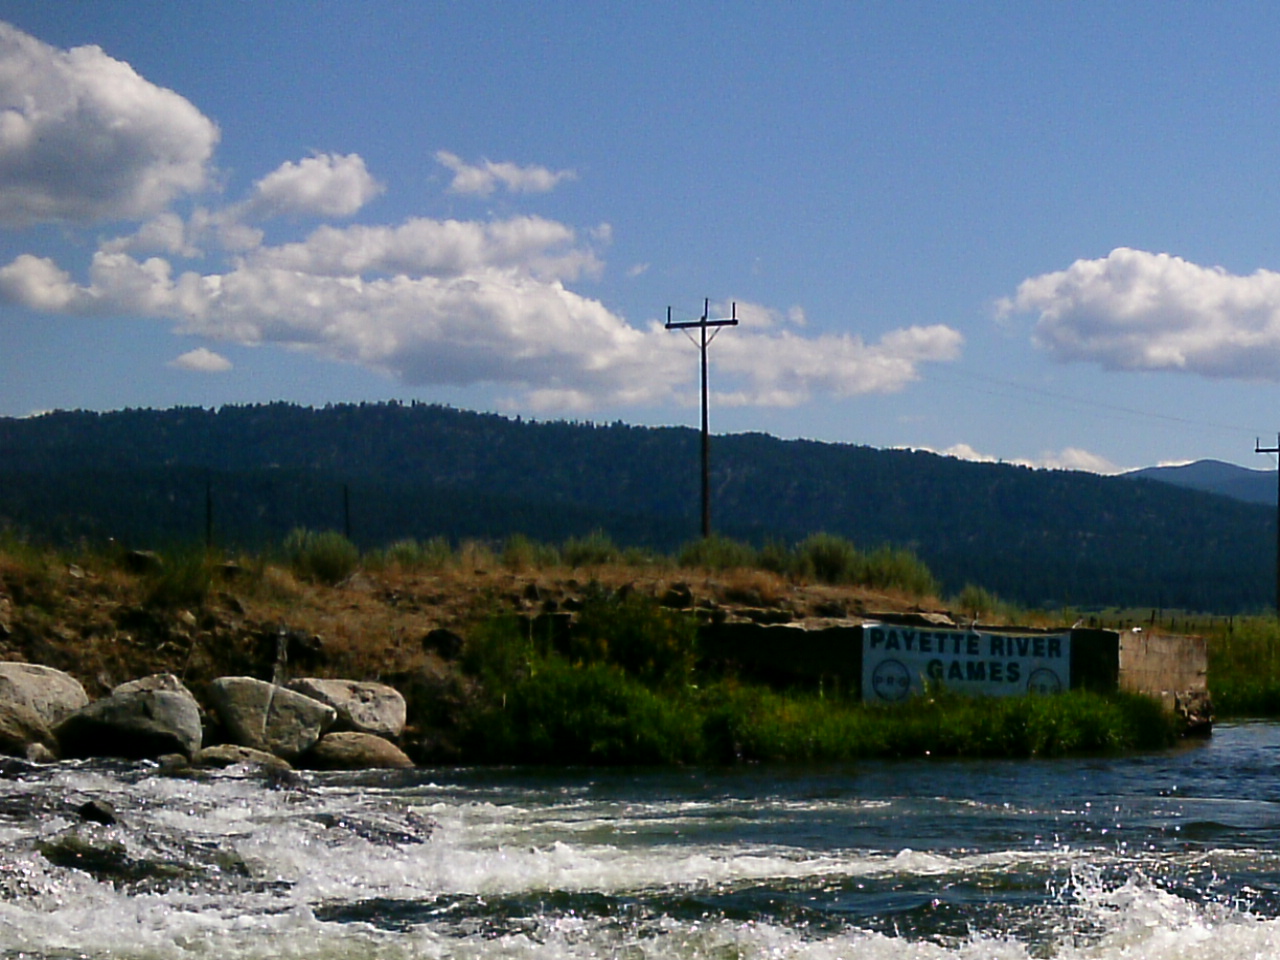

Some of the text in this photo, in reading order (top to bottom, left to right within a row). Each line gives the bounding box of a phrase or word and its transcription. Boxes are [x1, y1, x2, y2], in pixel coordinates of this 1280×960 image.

[870, 629, 1061, 657] PAYETTE RIVER
[927, 659, 1020, 682] GAMES
